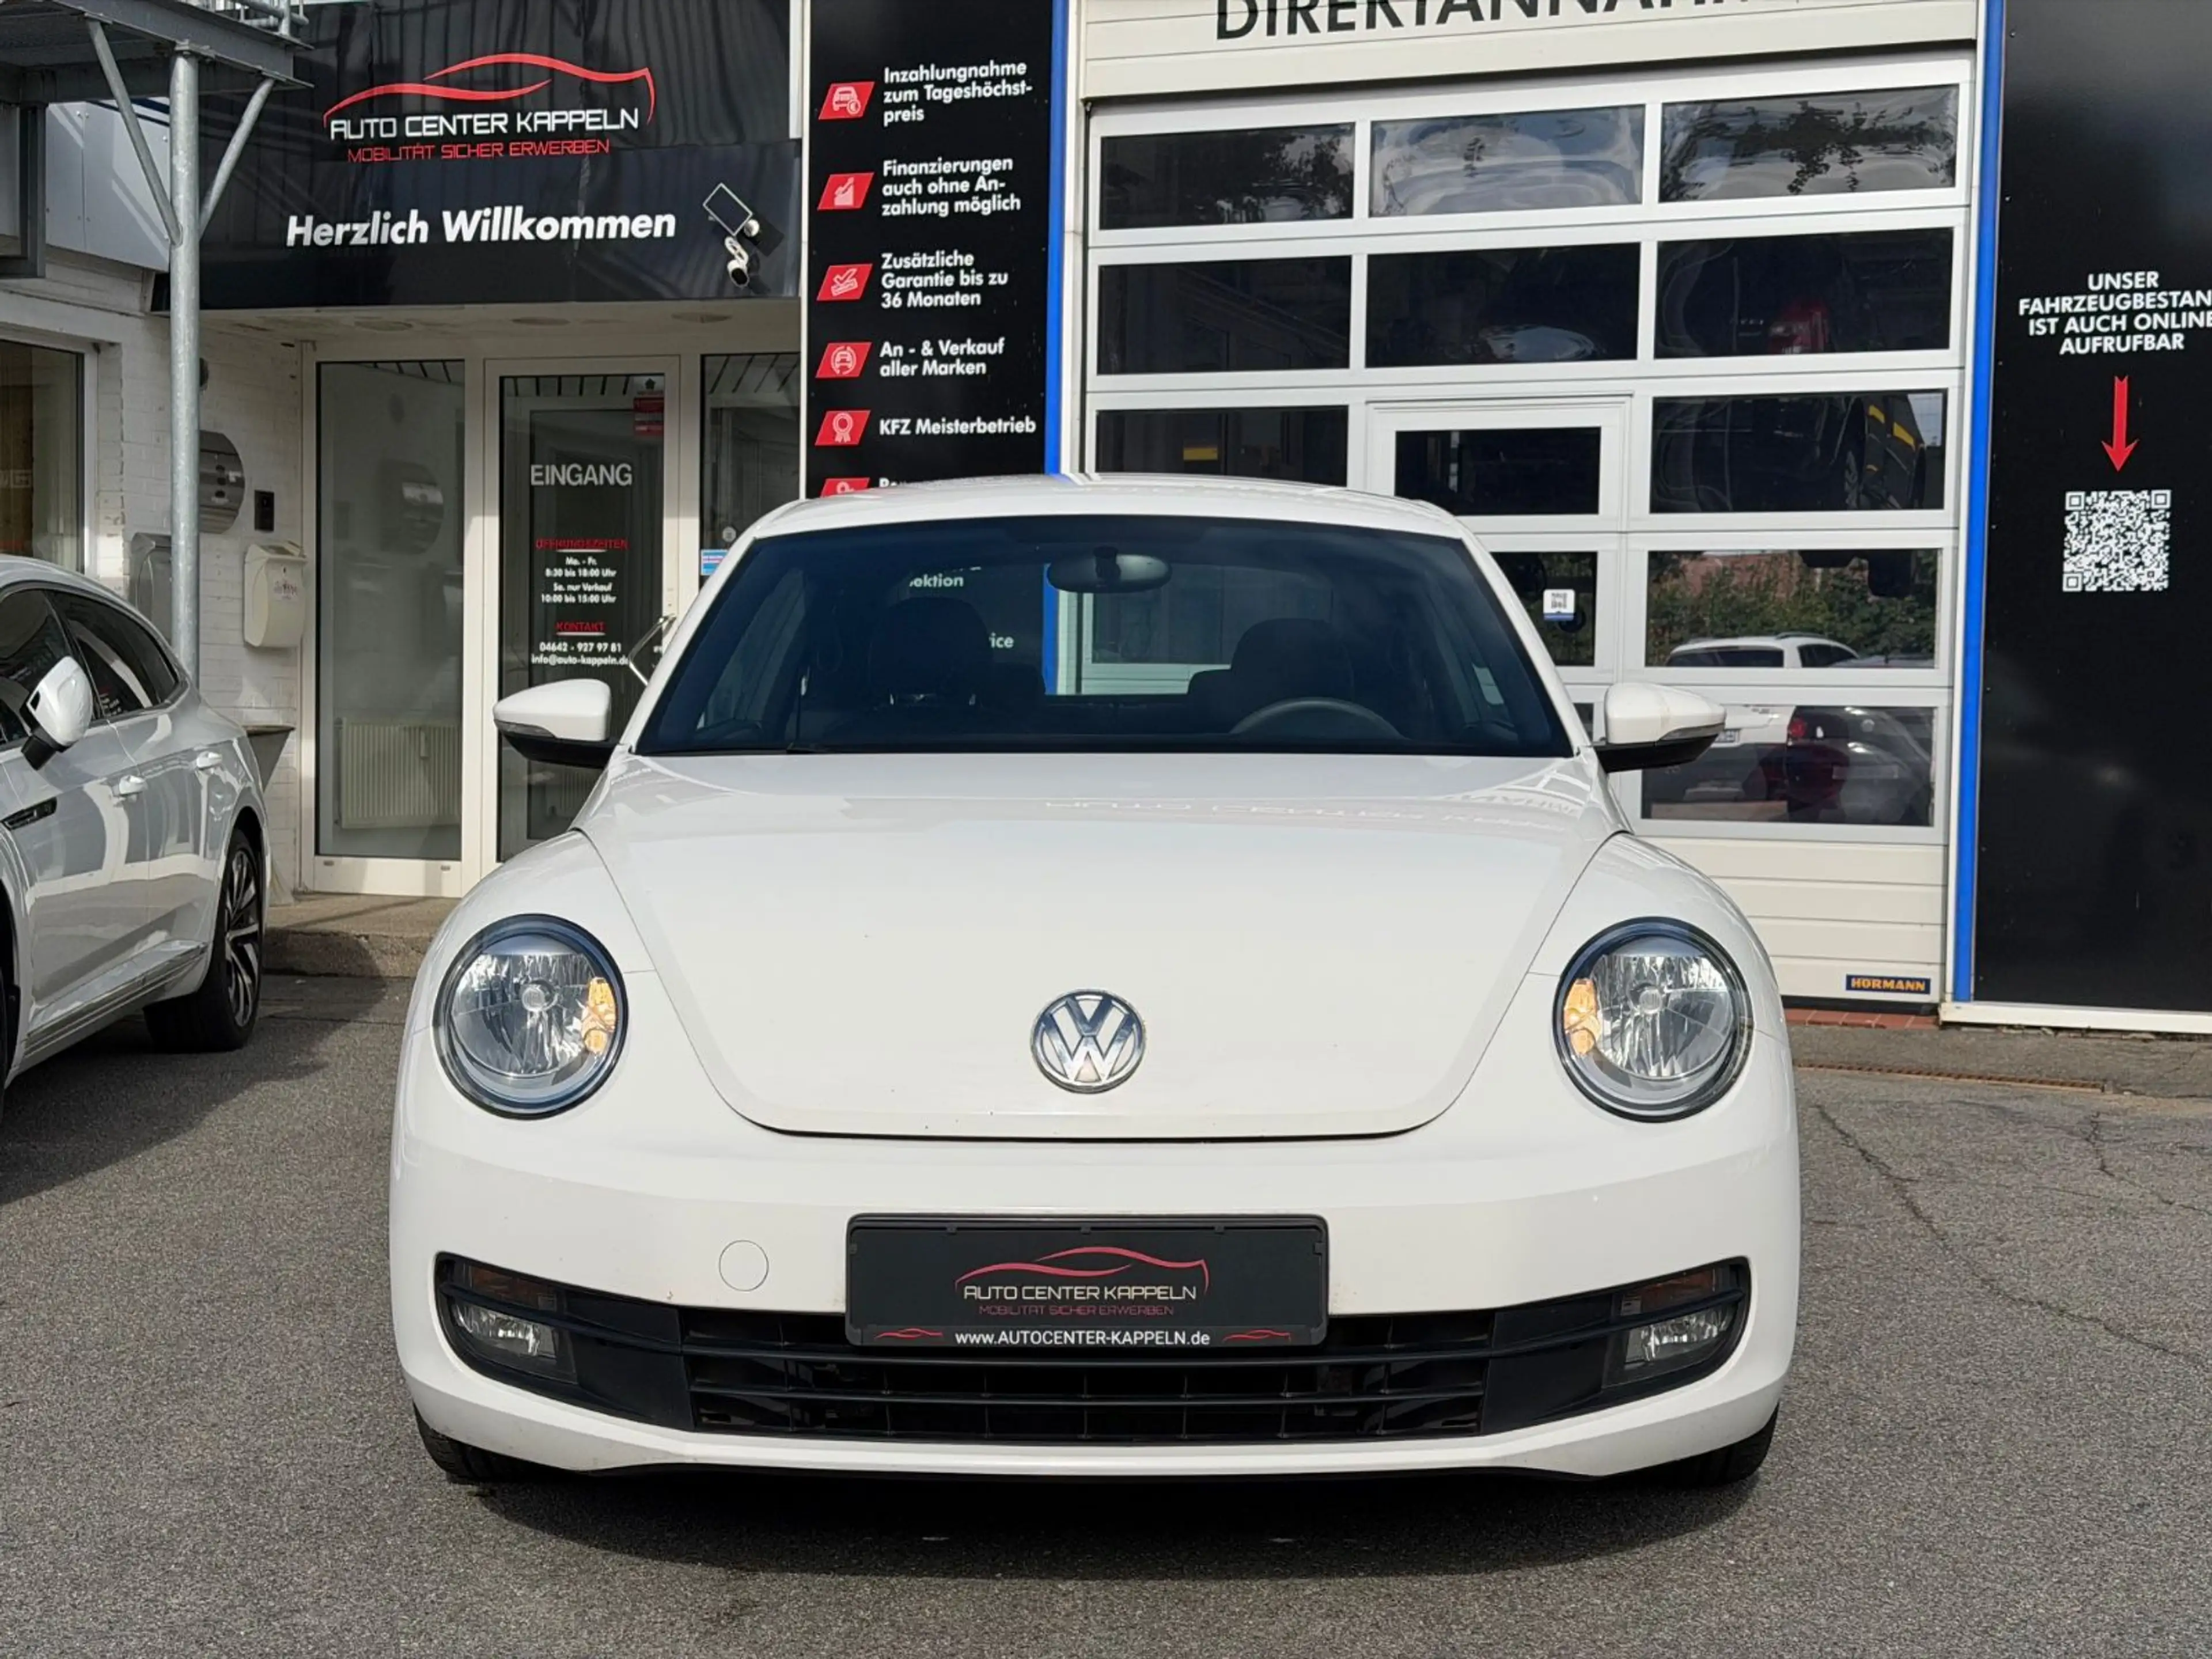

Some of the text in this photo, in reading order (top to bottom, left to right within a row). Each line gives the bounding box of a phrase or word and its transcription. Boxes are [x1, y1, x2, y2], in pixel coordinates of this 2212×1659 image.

[884, 60, 1027, 83] Inzahlungnahme
[883, 79, 1032, 105] zum Tageshöchst-
[331, 108, 639, 140] AUTO CENTER KAPPELN
[883, 104, 925, 128] preis
[441, 142, 504, 159] SICHER
[509, 139, 609, 157] ERWERBEN
[882, 157, 1013, 178] Finanzierungen
[882, 175, 1006, 196] auch ohne An-
[881, 193, 1021, 218] zahlung möglich
[286, 206, 676, 248] Herzlich Willkommen
[881, 249, 975, 270] Zusätzliche
[881, 270, 1009, 289] Garantie bis zu
[2087, 271, 2160, 291] UNSER
[881, 291, 981, 309] 36 Monaten
[2018, 289, 2212, 316] FAHRZEUGBESTAN
[2028, 317, 2059, 336] IST
[2063, 314, 2127, 334] AUCH
[879, 341, 904, 358] An
[921, 340, 934, 356] &
[938, 337, 1005, 356] Verkauf
[2059, 333, 2185, 355] AUFRUFBAR
[880, 357, 987, 377] aller Marken
[879, 415, 1036, 435] KFZ Meisterbetrieb
[530, 463, 633, 486] EINGANG
[564, 568, 576, 577] bis
[601, 568, 617, 577] Uhr
[581, 582, 613, 592] Verkauf
[564, 593, 576, 603] bis
[601, 593, 617, 603] Uhr
[539, 642, 568, 652] 04642
[577, 642, 593, 652] 927
[596, 642, 608, 652] 97
[611, 642, 622, 652] 81
[964, 1286, 1196, 1300] AUTO CENTER KAPPELN
[955, 1330, 1210, 1346] www.AUTOCENTER-KAPPELN.de
